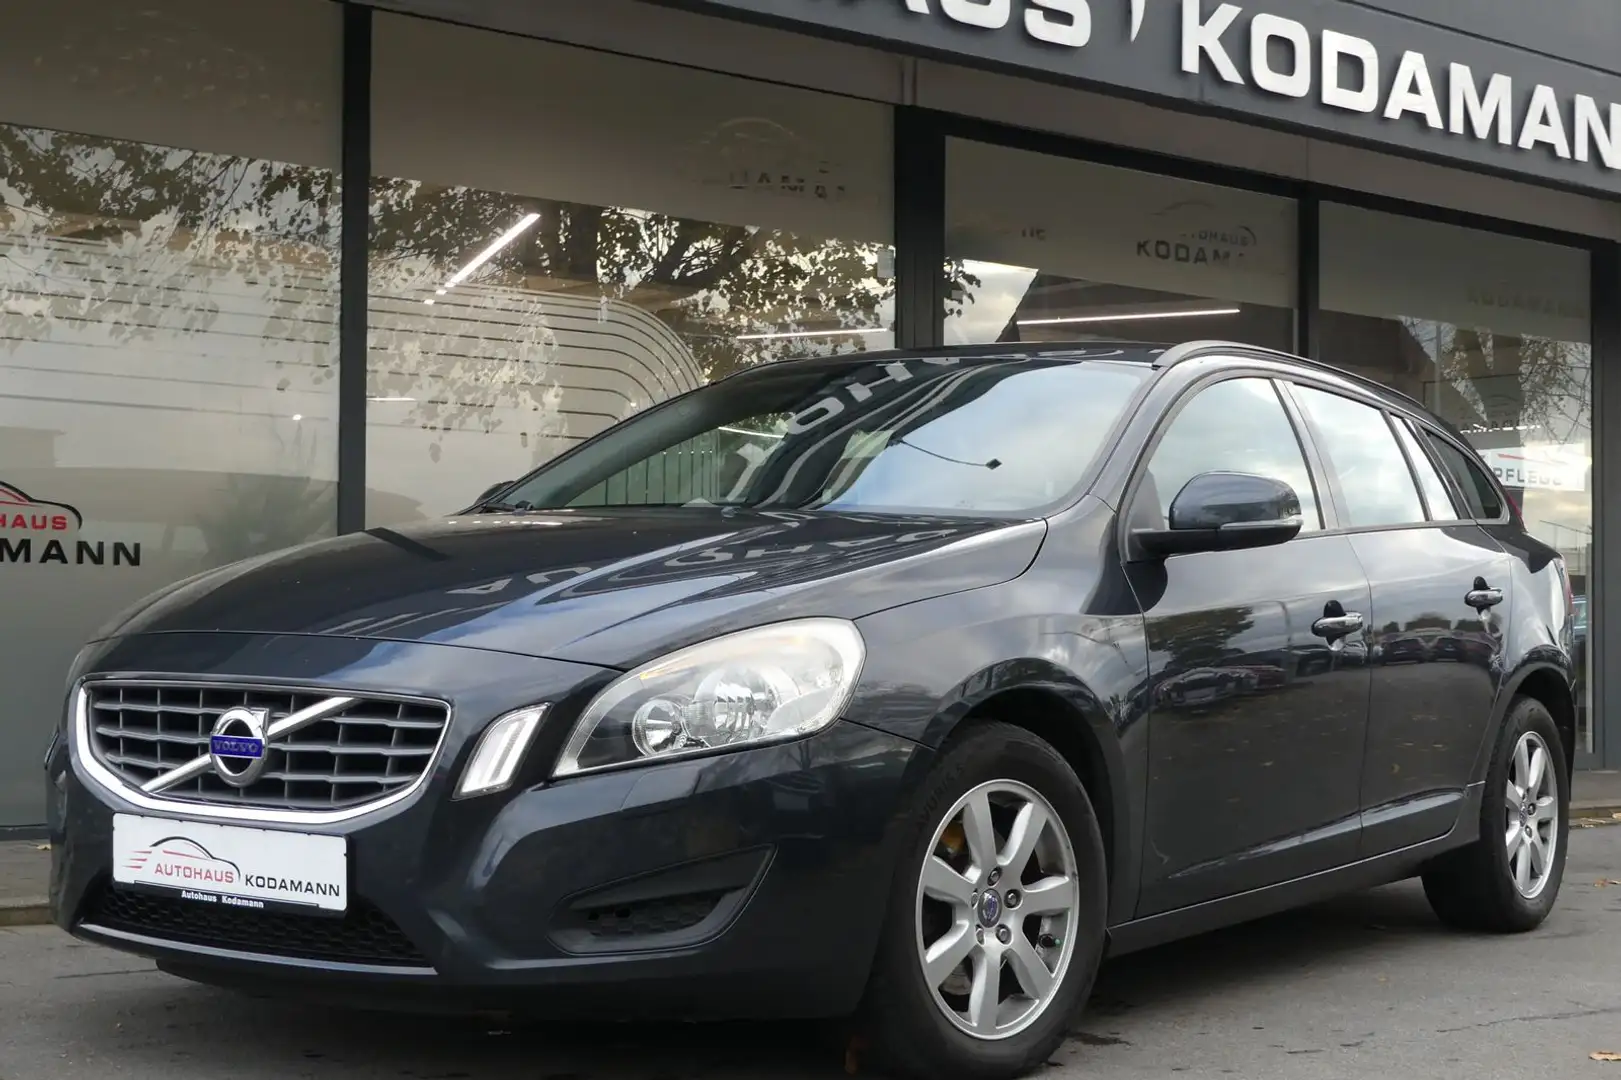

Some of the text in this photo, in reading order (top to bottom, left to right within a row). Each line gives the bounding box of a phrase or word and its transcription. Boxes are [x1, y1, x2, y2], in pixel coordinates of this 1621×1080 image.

[213, 739, 259, 753] VOLVO
[154, 862, 341, 897] AUTOHAUS KODAMANN
[181, 890, 265, 909] Autohaus Kodamann
